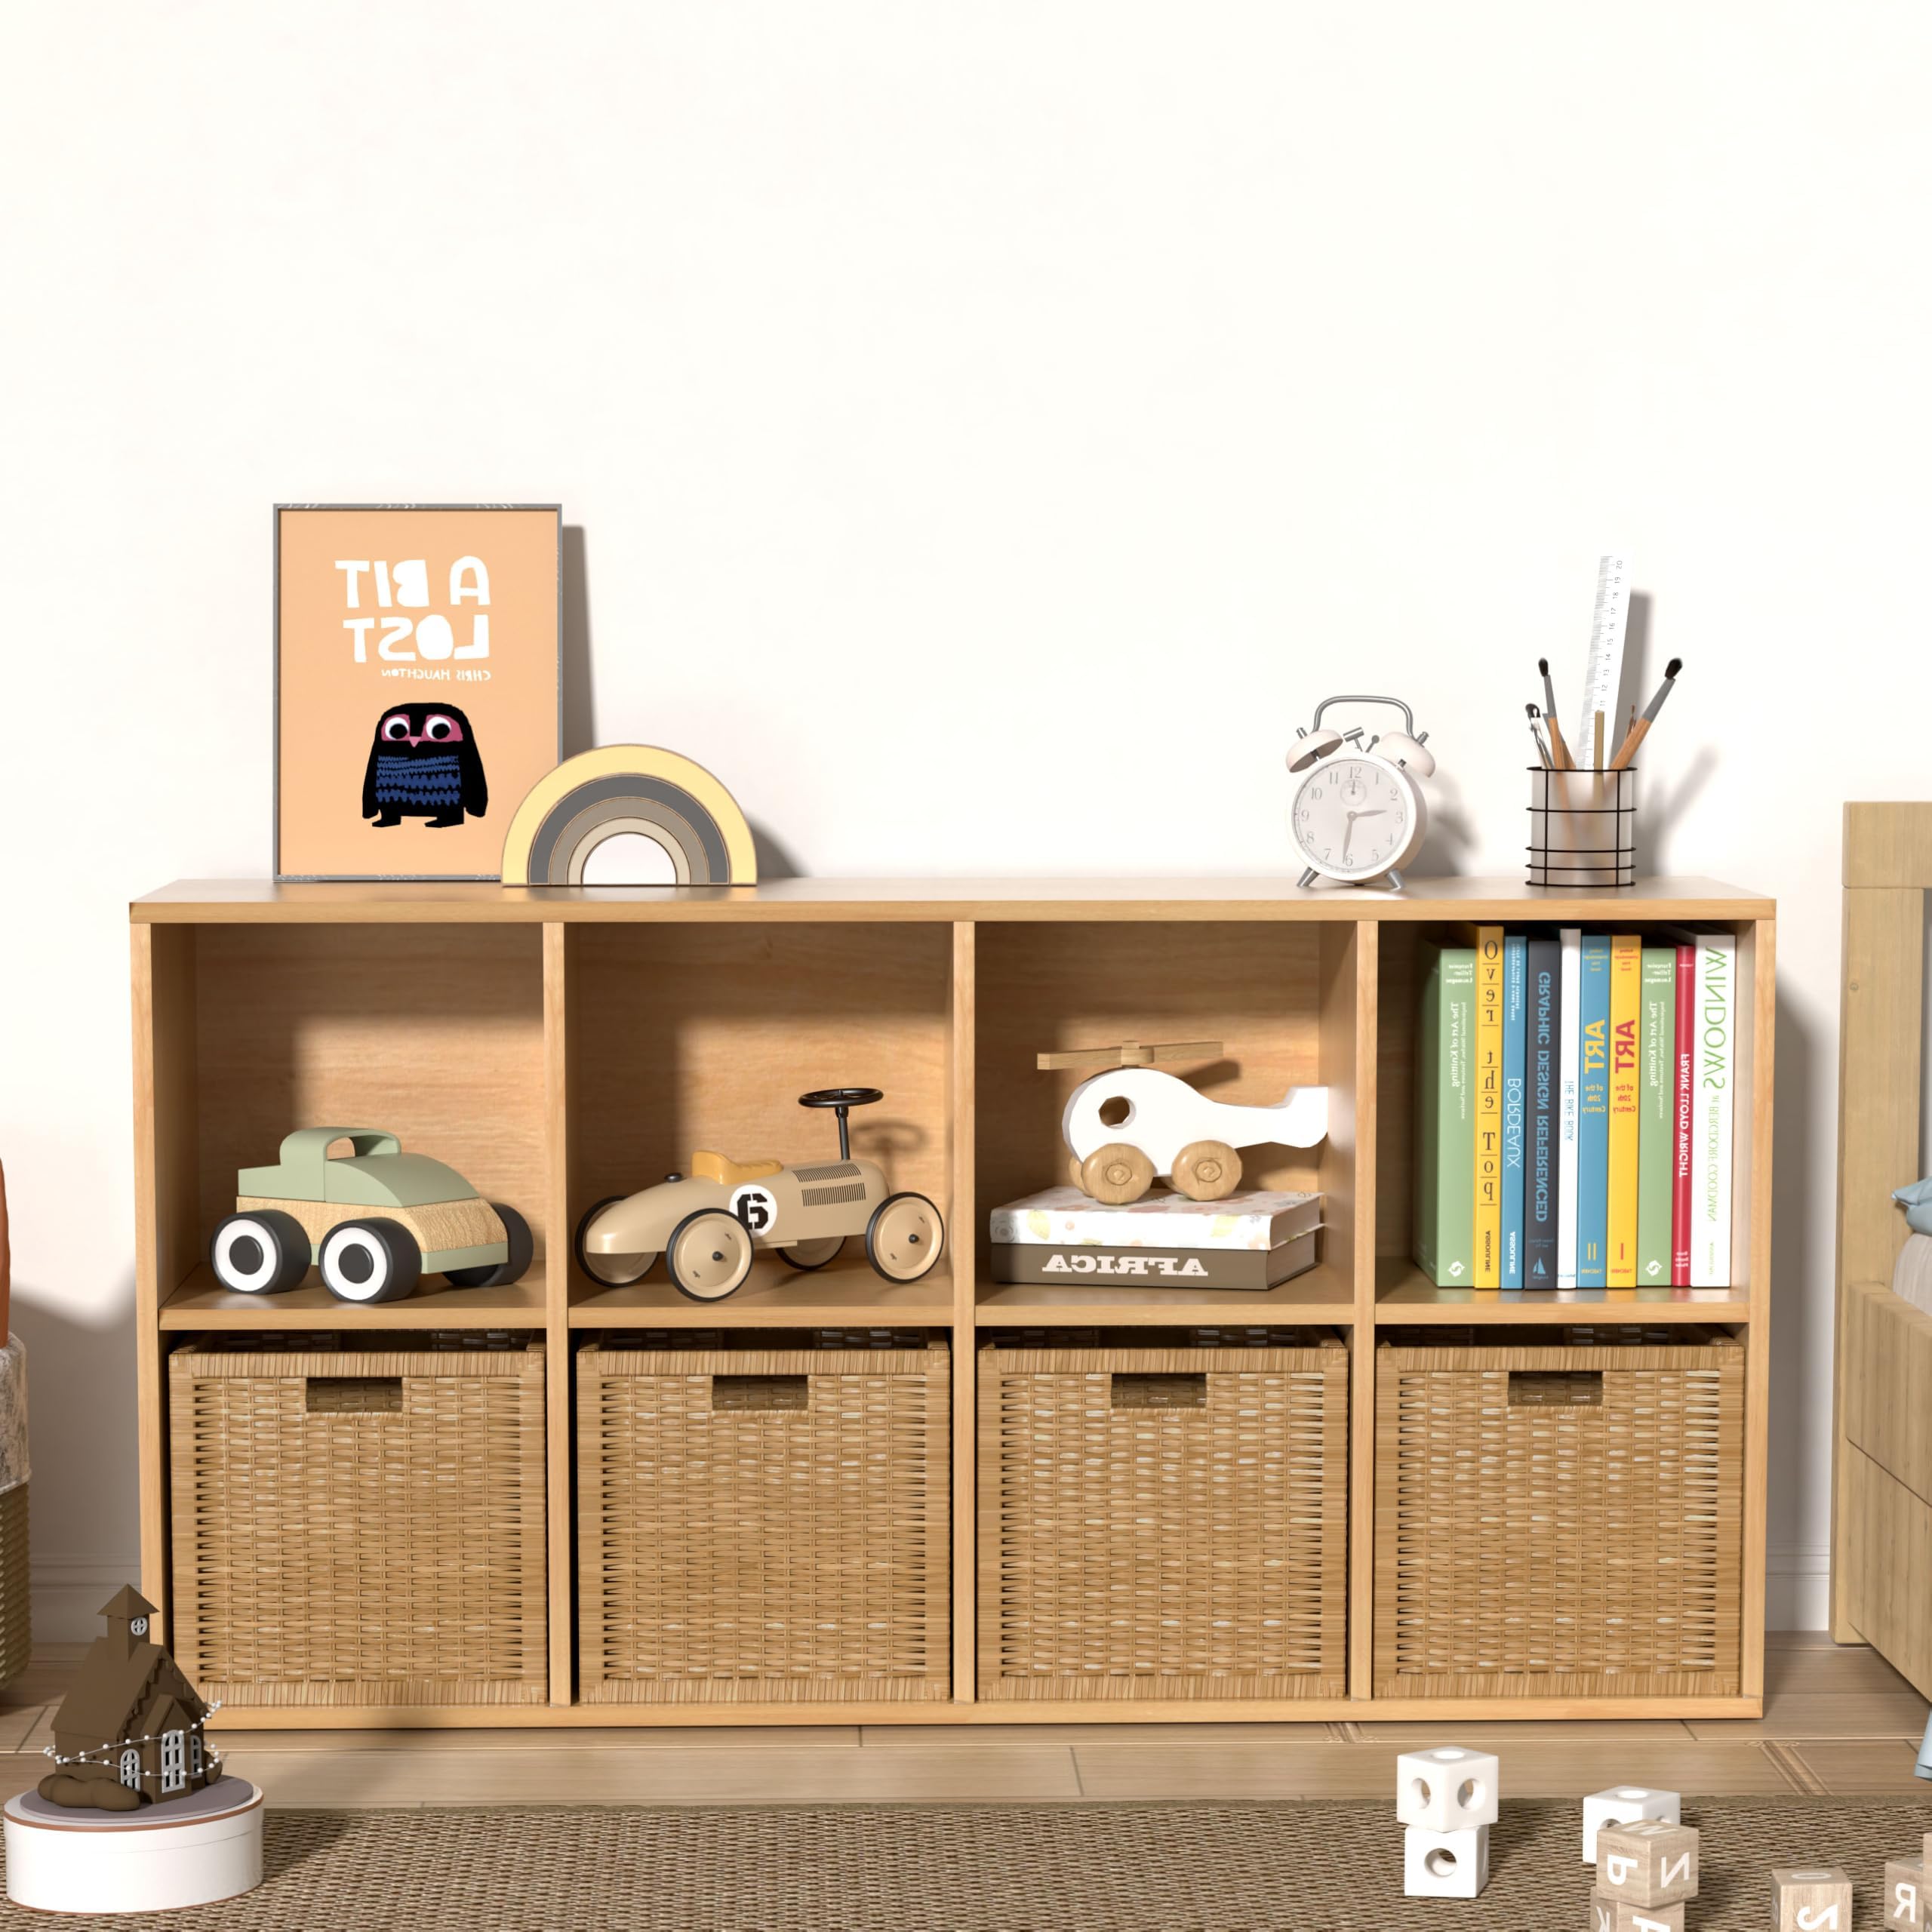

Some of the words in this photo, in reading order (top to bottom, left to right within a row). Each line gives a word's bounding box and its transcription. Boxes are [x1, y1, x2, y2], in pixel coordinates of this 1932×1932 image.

[1330, 772, 1338, 784] 11
[1349, 766, 1362, 778] 12
[1311, 787, 1322, 800] 10
[1390, 789, 1398, 801] 2
[1301, 810, 1309, 822] 9
[1395, 811, 1403, 823] 3
[1306, 832, 1315, 844] 8
[1324, 848, 1331, 860] 7
[1346, 854, 1353, 866] 6
[1371, 849, 1379, 861] 5
[737, 1193, 768, 1229] 6
